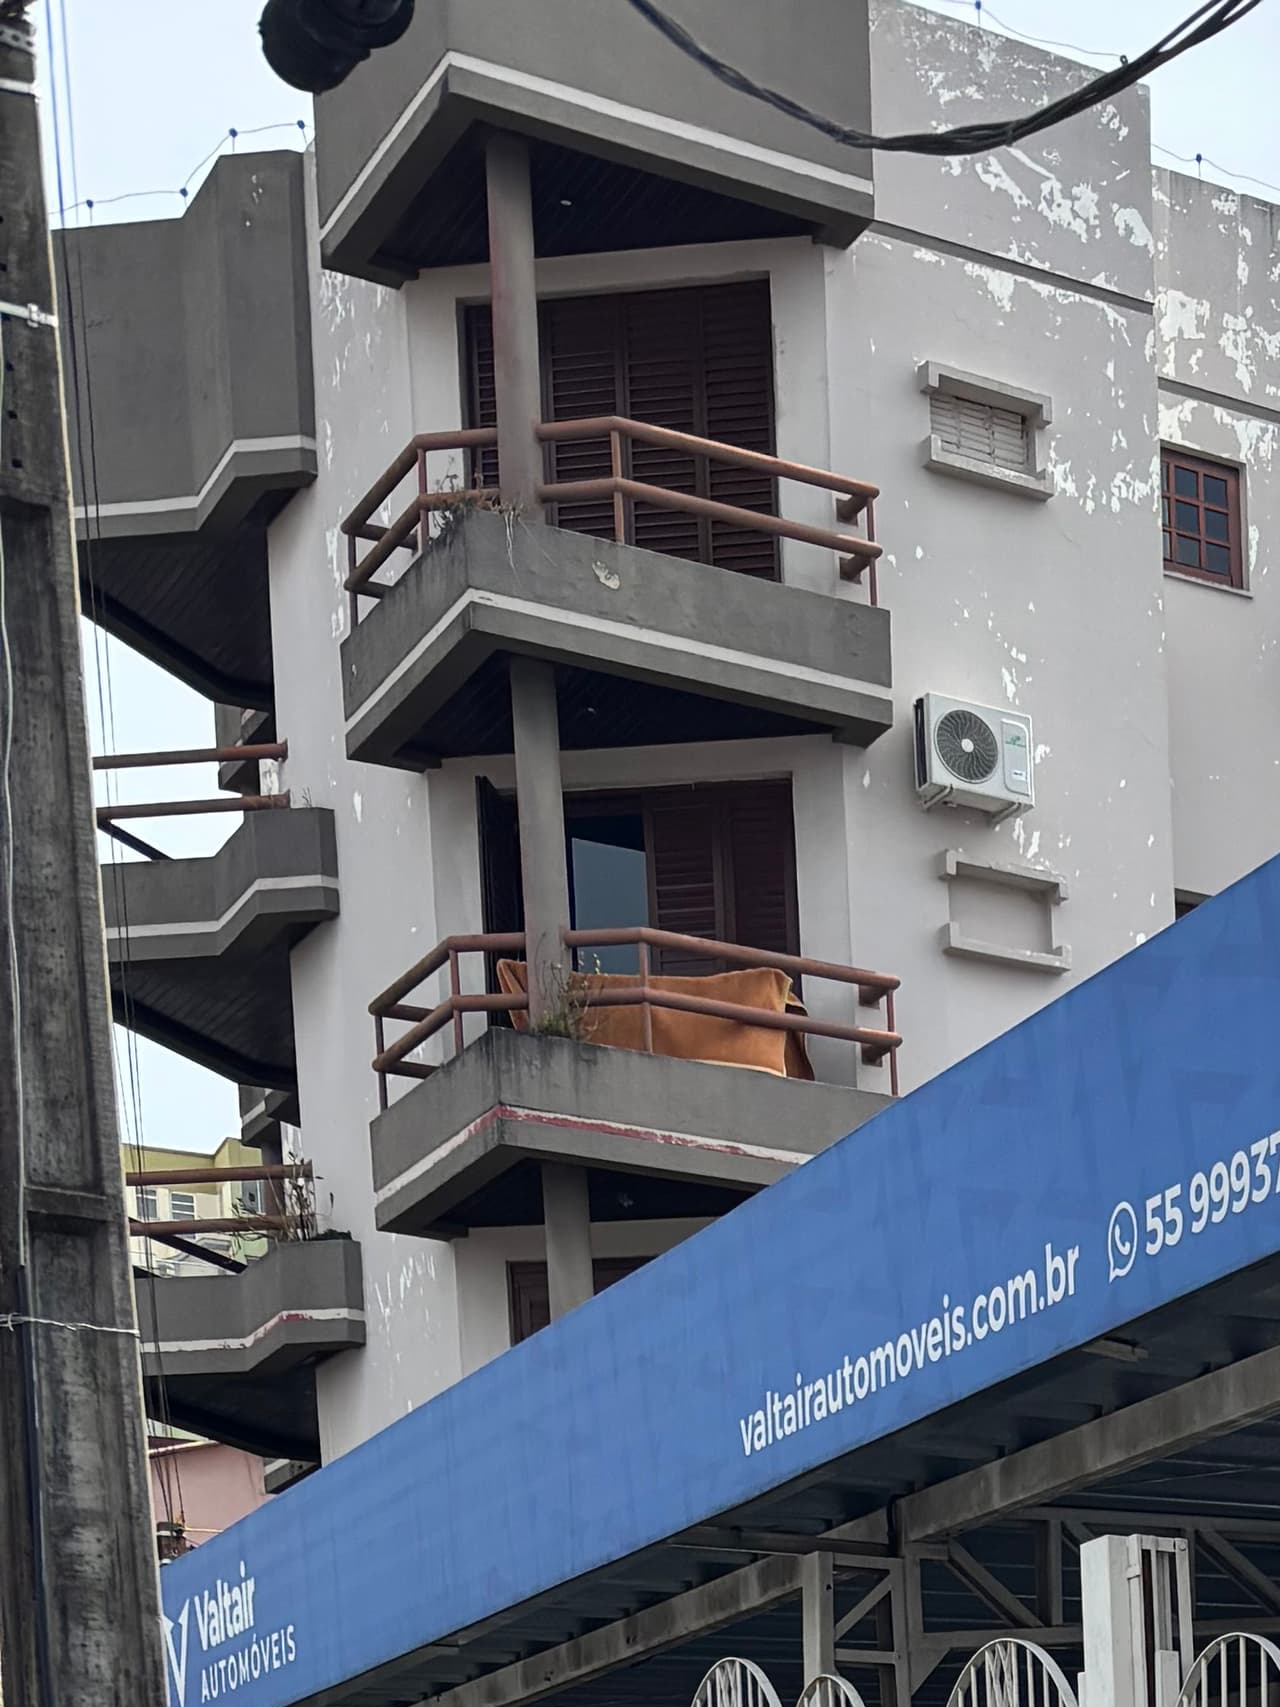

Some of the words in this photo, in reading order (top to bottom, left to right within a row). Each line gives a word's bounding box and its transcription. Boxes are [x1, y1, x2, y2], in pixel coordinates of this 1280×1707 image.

[1144, 1184, 1184, 1256] 55
[739, 1242, 1080, 1457] valtairautomoveis.com.br
[193, 1560, 255, 1651] Valtair
[202, 1623, 297, 1704] AUTOMÓVEIS
